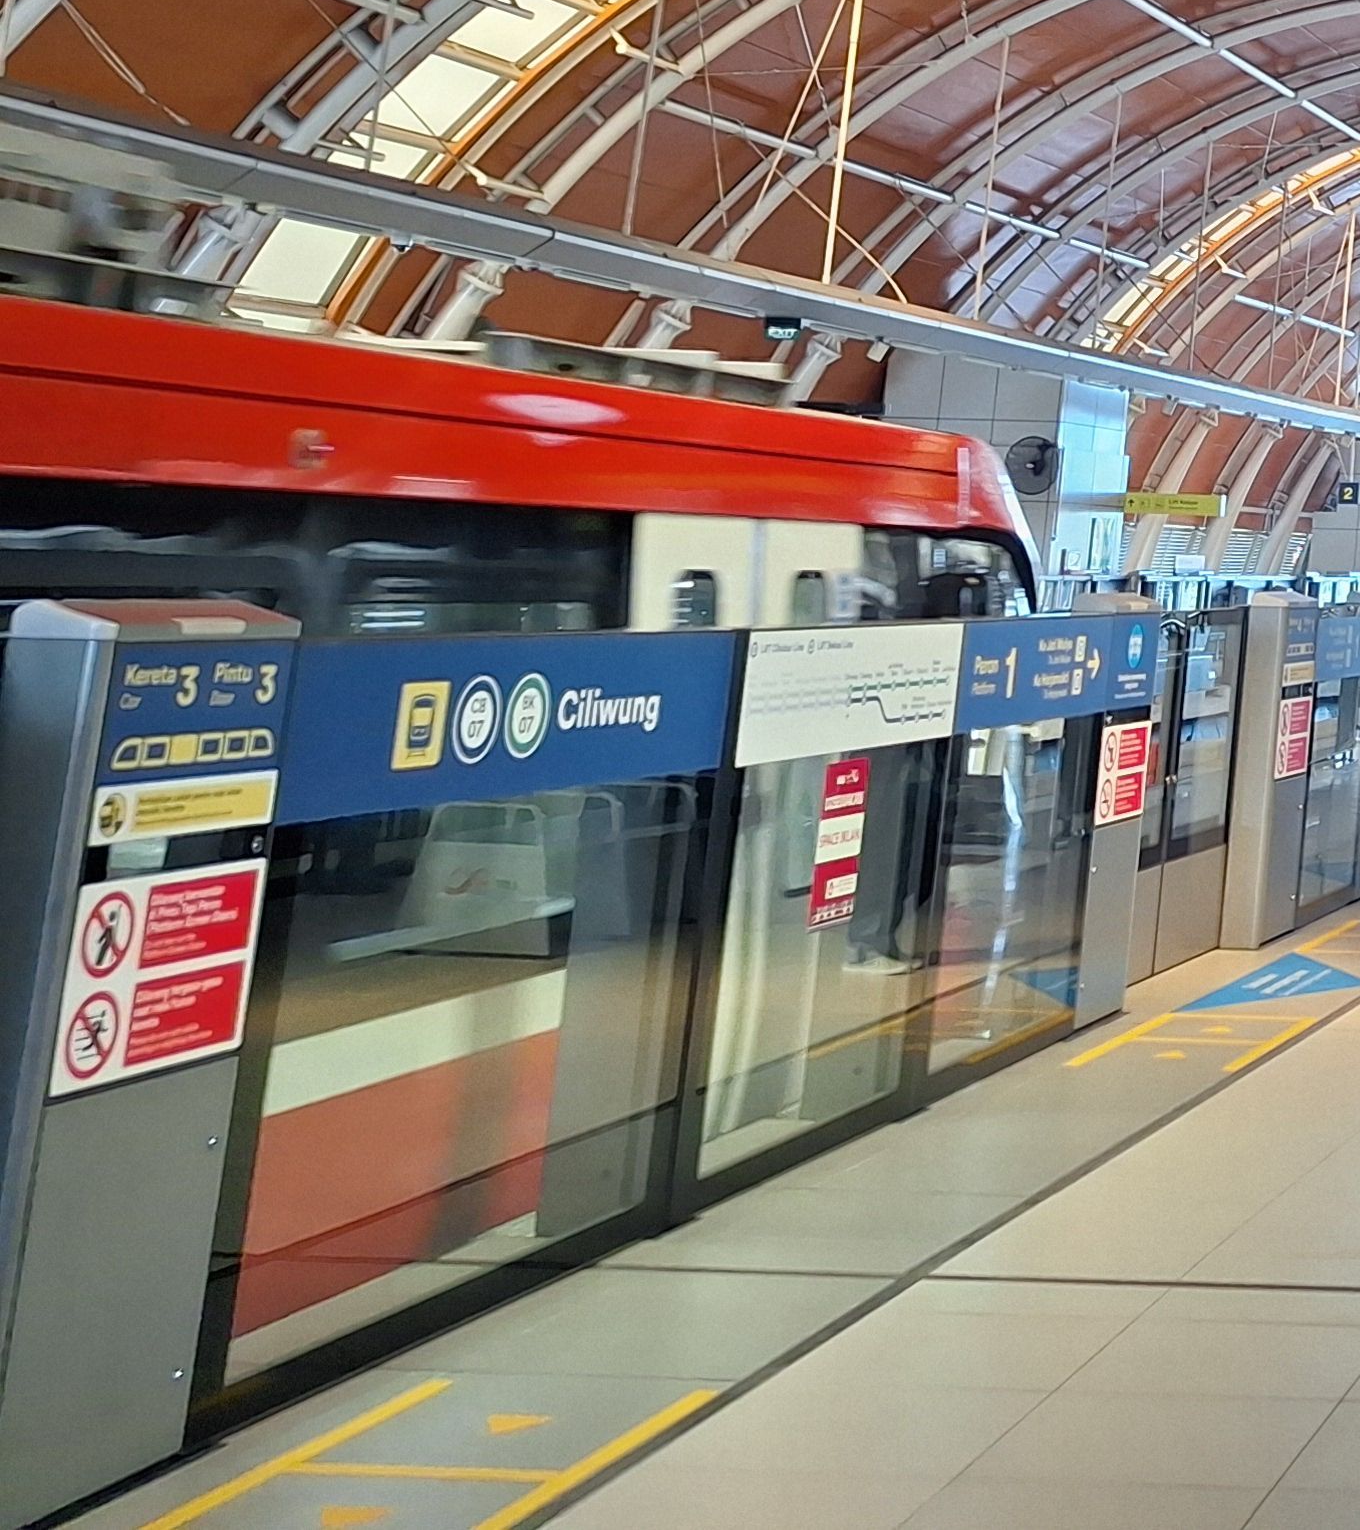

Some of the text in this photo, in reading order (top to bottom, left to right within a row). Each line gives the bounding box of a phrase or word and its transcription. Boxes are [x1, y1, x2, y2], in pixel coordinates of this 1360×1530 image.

[1342, 486, 1354, 500] 2
[124, 661, 279, 707] Kereta 3 Pintu 3
[1005, 647, 1018, 699] 1
[518, 715, 535, 734] 07
[556, 687, 662, 733] Ciliwung
[467, 719, 485, 738] 07
